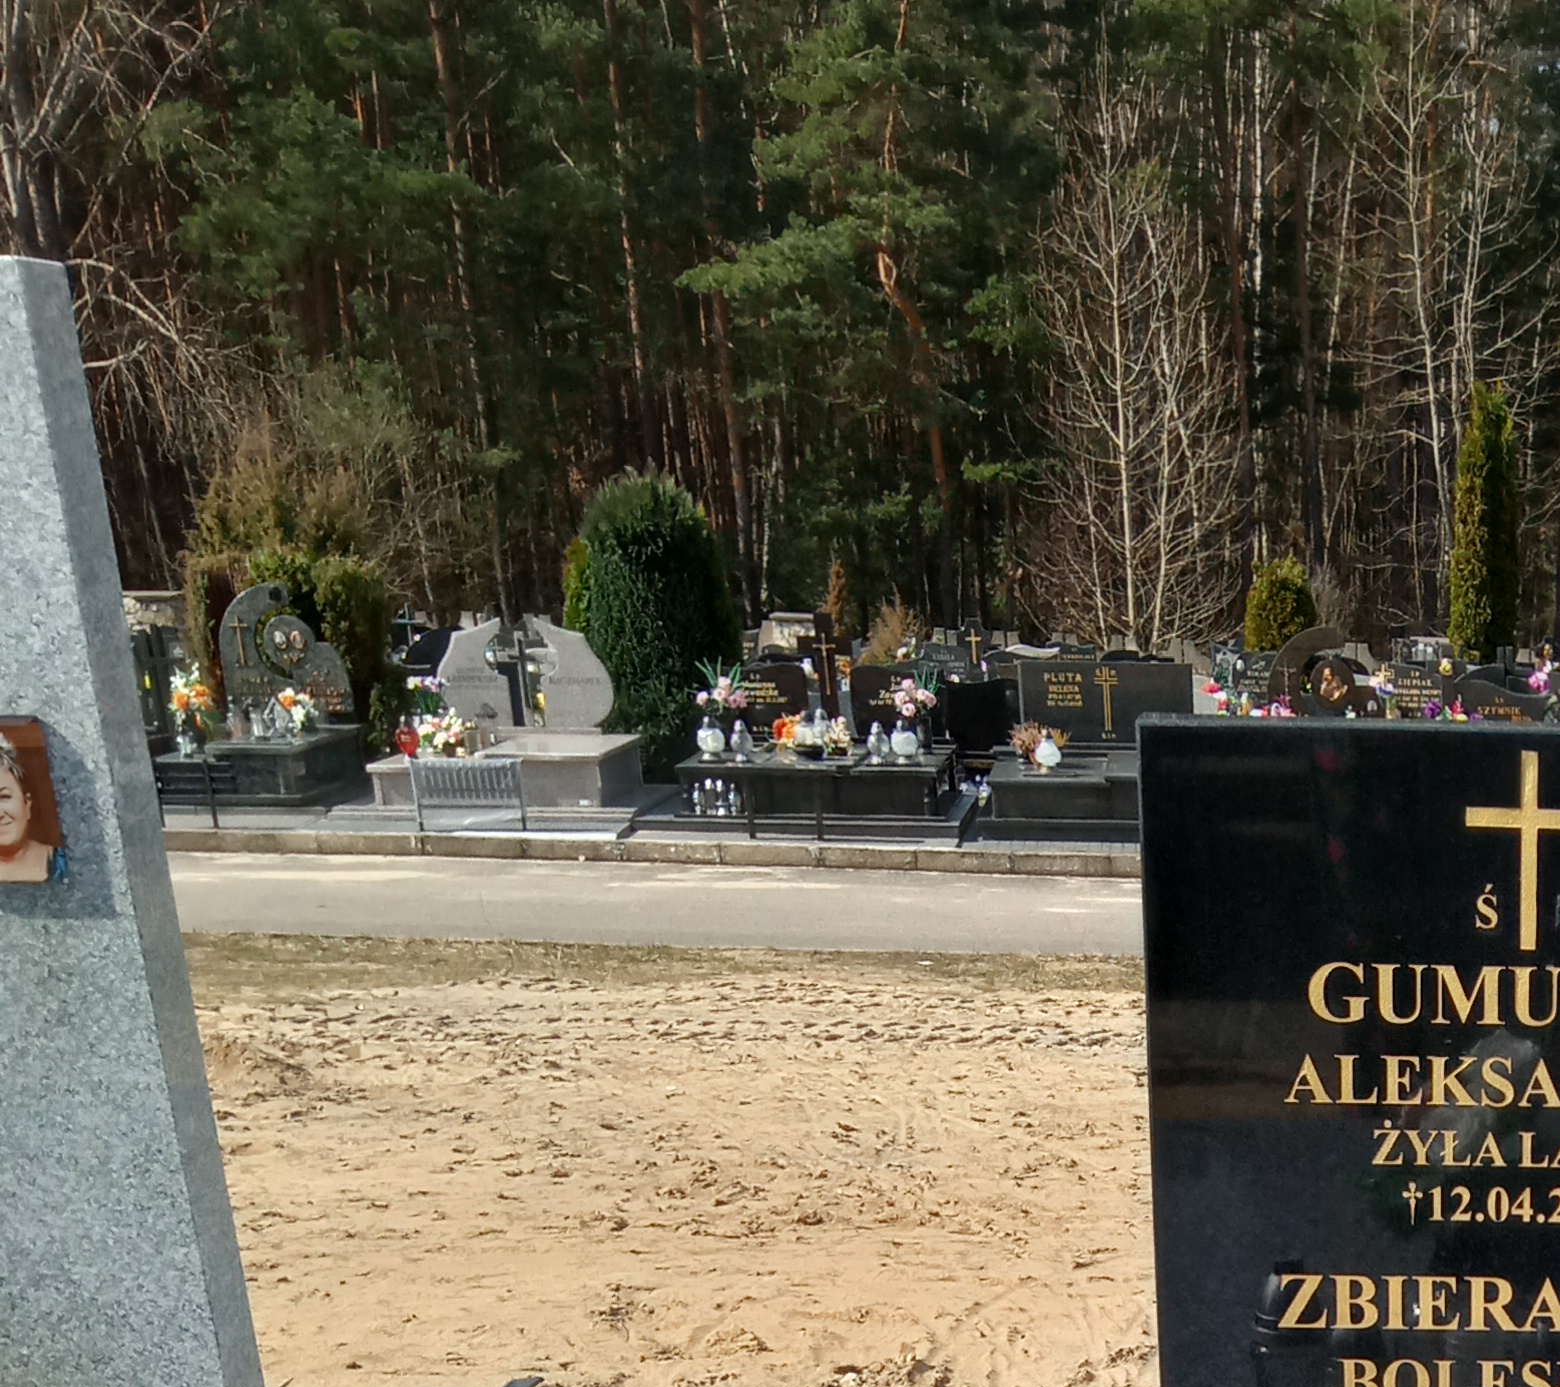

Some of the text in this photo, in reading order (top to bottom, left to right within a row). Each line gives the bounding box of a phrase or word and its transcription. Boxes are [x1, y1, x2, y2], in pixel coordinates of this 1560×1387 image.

[1043, 671, 1082, 683] PLUTA
[1475, 884, 1499, 930] Ś
[1371, 1119, 1507, 1168] ŻYŁA
